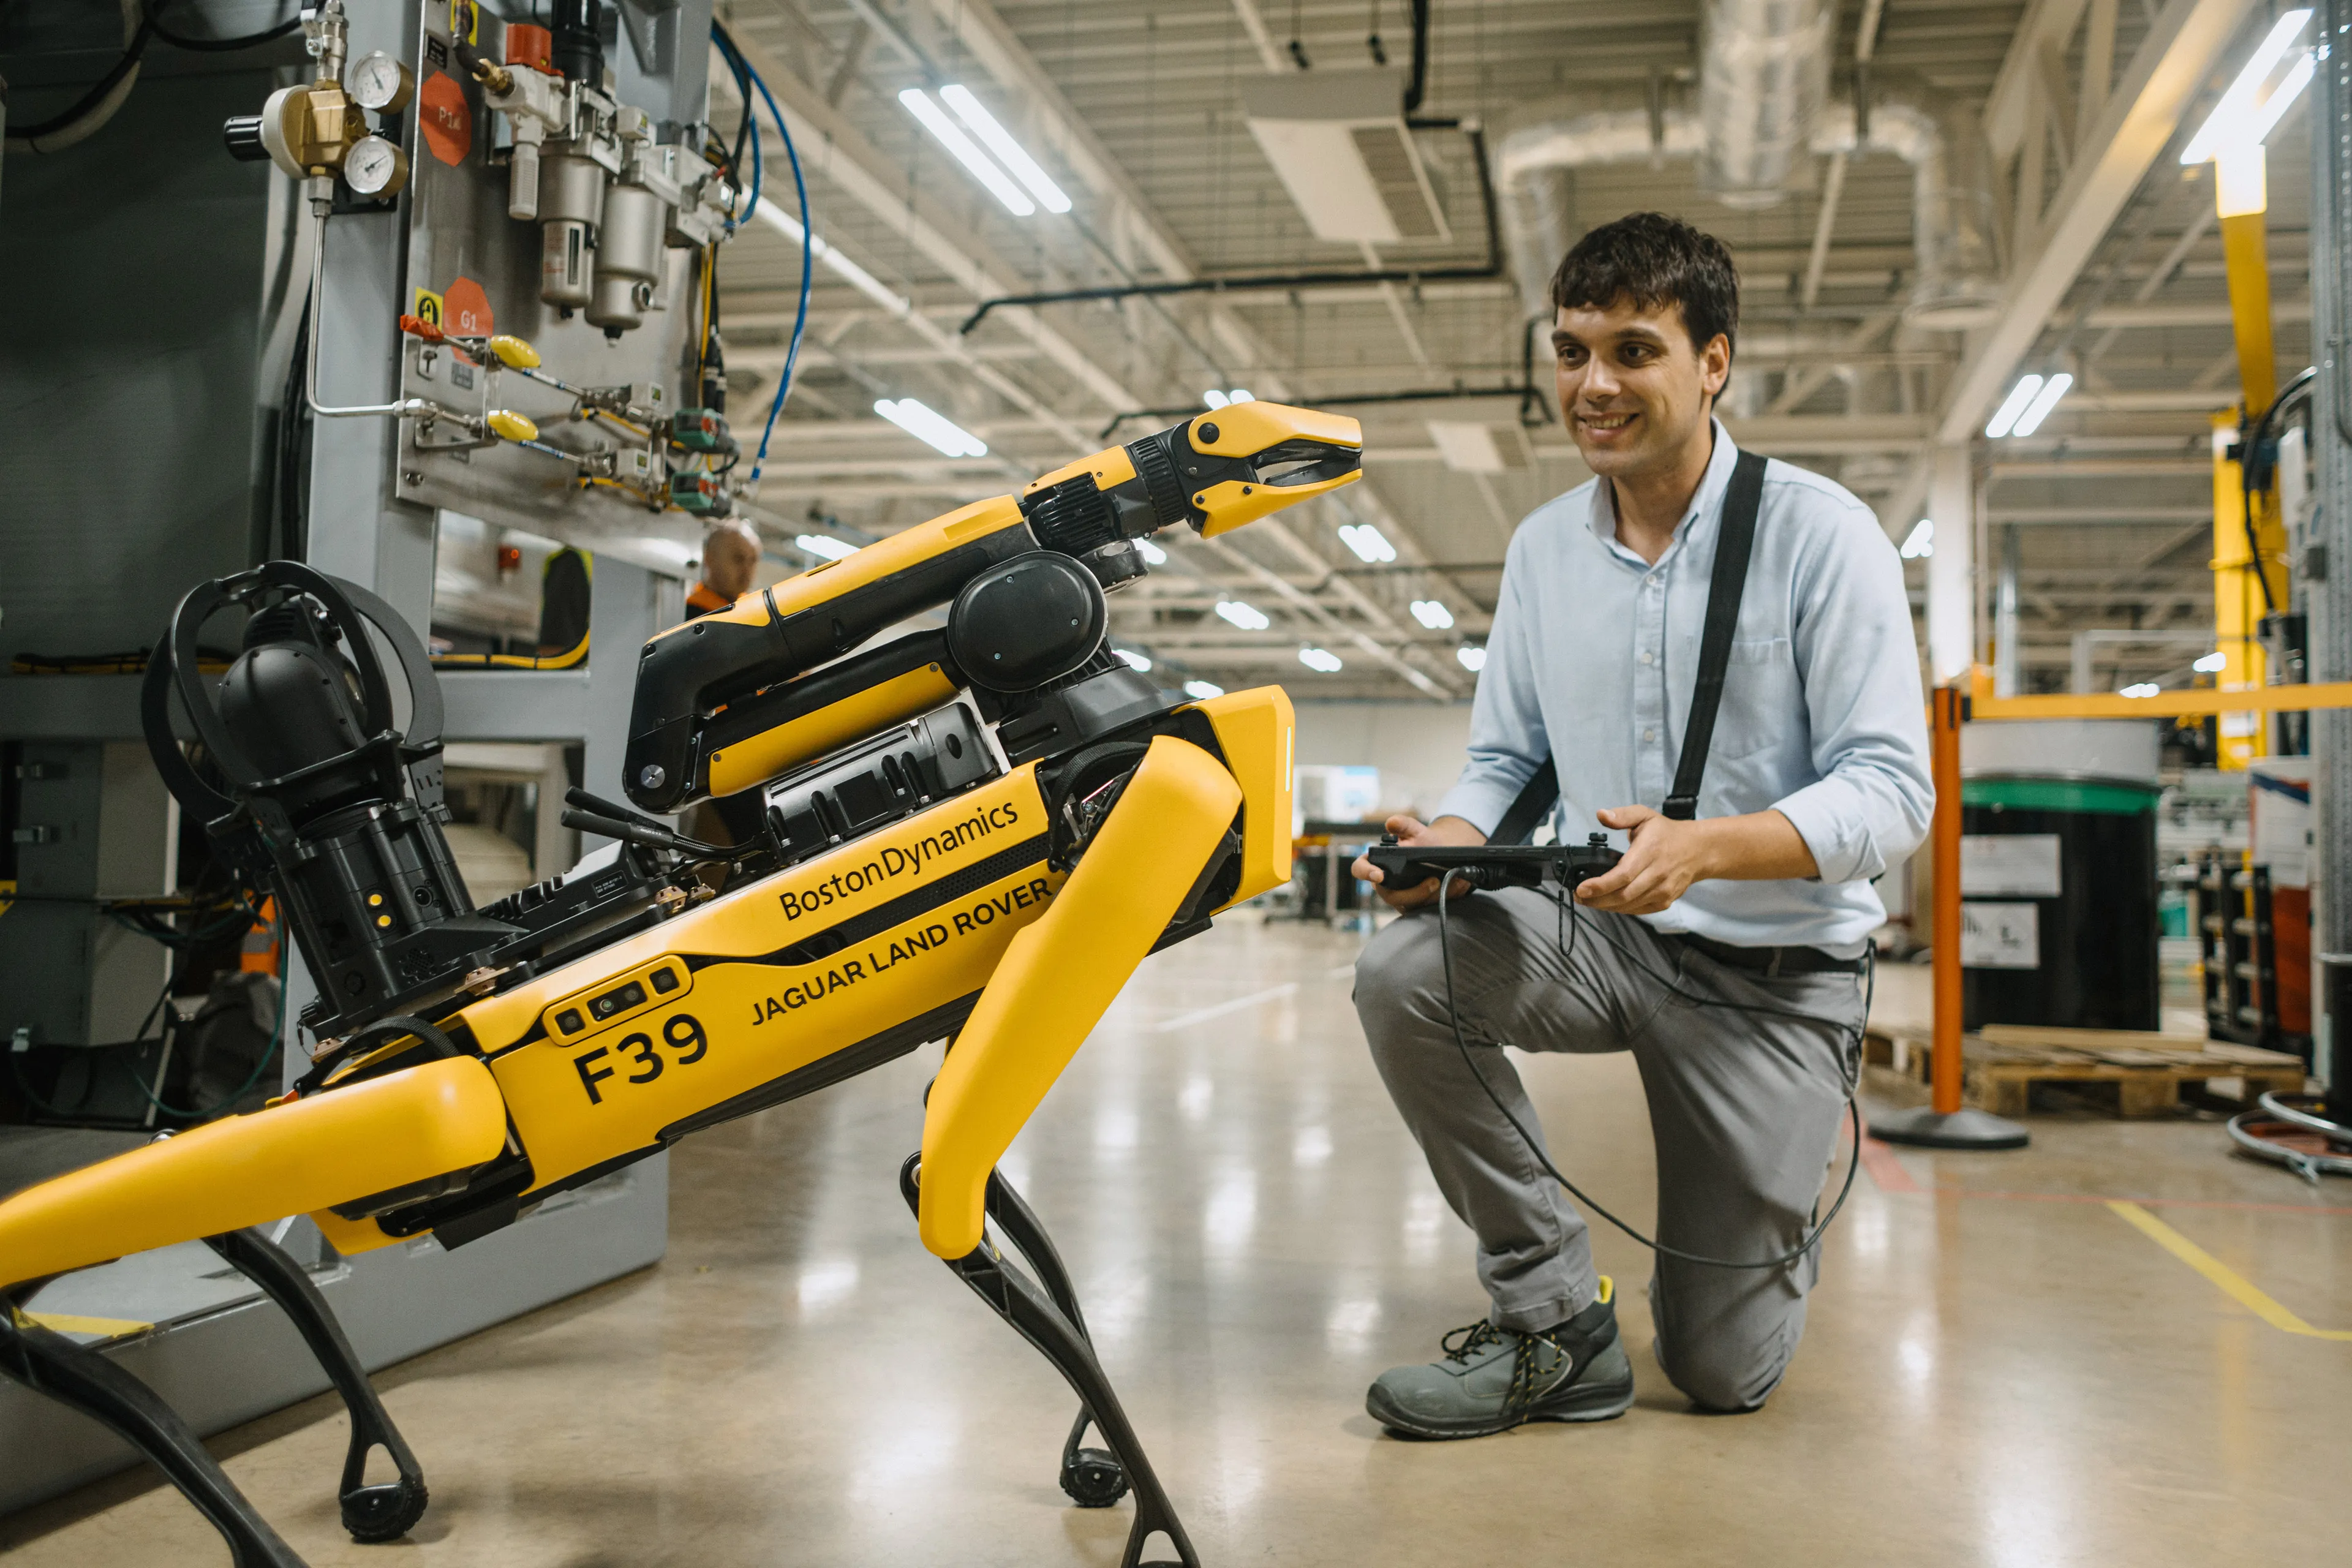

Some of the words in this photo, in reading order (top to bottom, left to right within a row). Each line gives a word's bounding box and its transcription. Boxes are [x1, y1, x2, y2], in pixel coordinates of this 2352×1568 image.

[461, 310, 477, 332] G1
[778, 802, 1018, 921] BostonDynamics
[752, 961, 867, 1026] JAGUAR
[869, 924, 949, 973] LAND
[952, 878, 1054, 935] ROVER
[573, 1014, 707, 1106] F39
